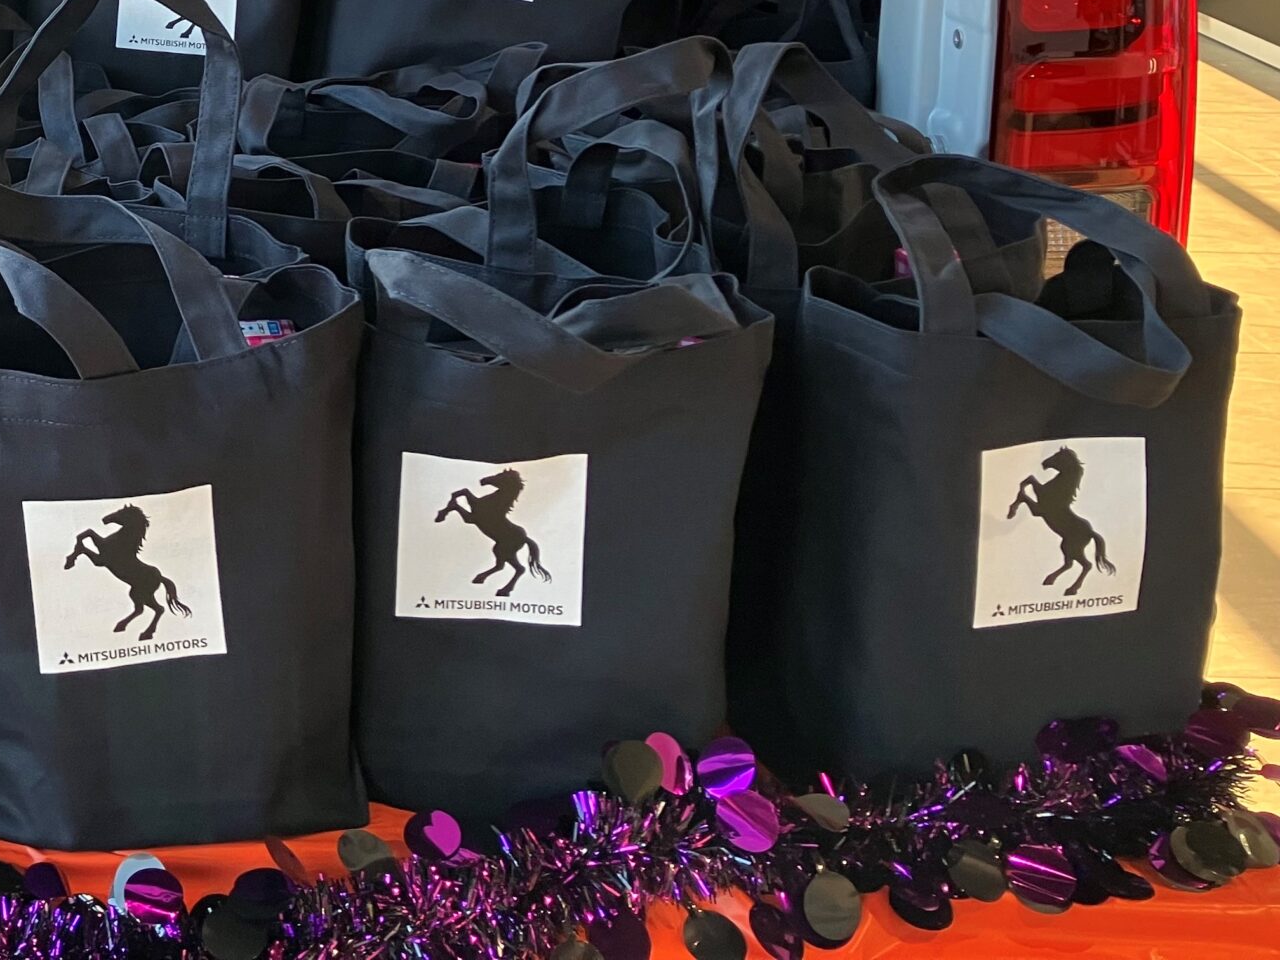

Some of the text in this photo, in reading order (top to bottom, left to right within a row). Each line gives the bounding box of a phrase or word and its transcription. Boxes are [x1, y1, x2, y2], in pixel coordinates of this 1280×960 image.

[140, 37, 206, 50] MITSUBISHI MOT
[434, 599, 564, 616] MITSUBISHI MOTORS
[1008, 595, 1124, 616] MITSUBISHI MOTORS
[78, 638, 208, 663] MITSUBISHI MOTORS
